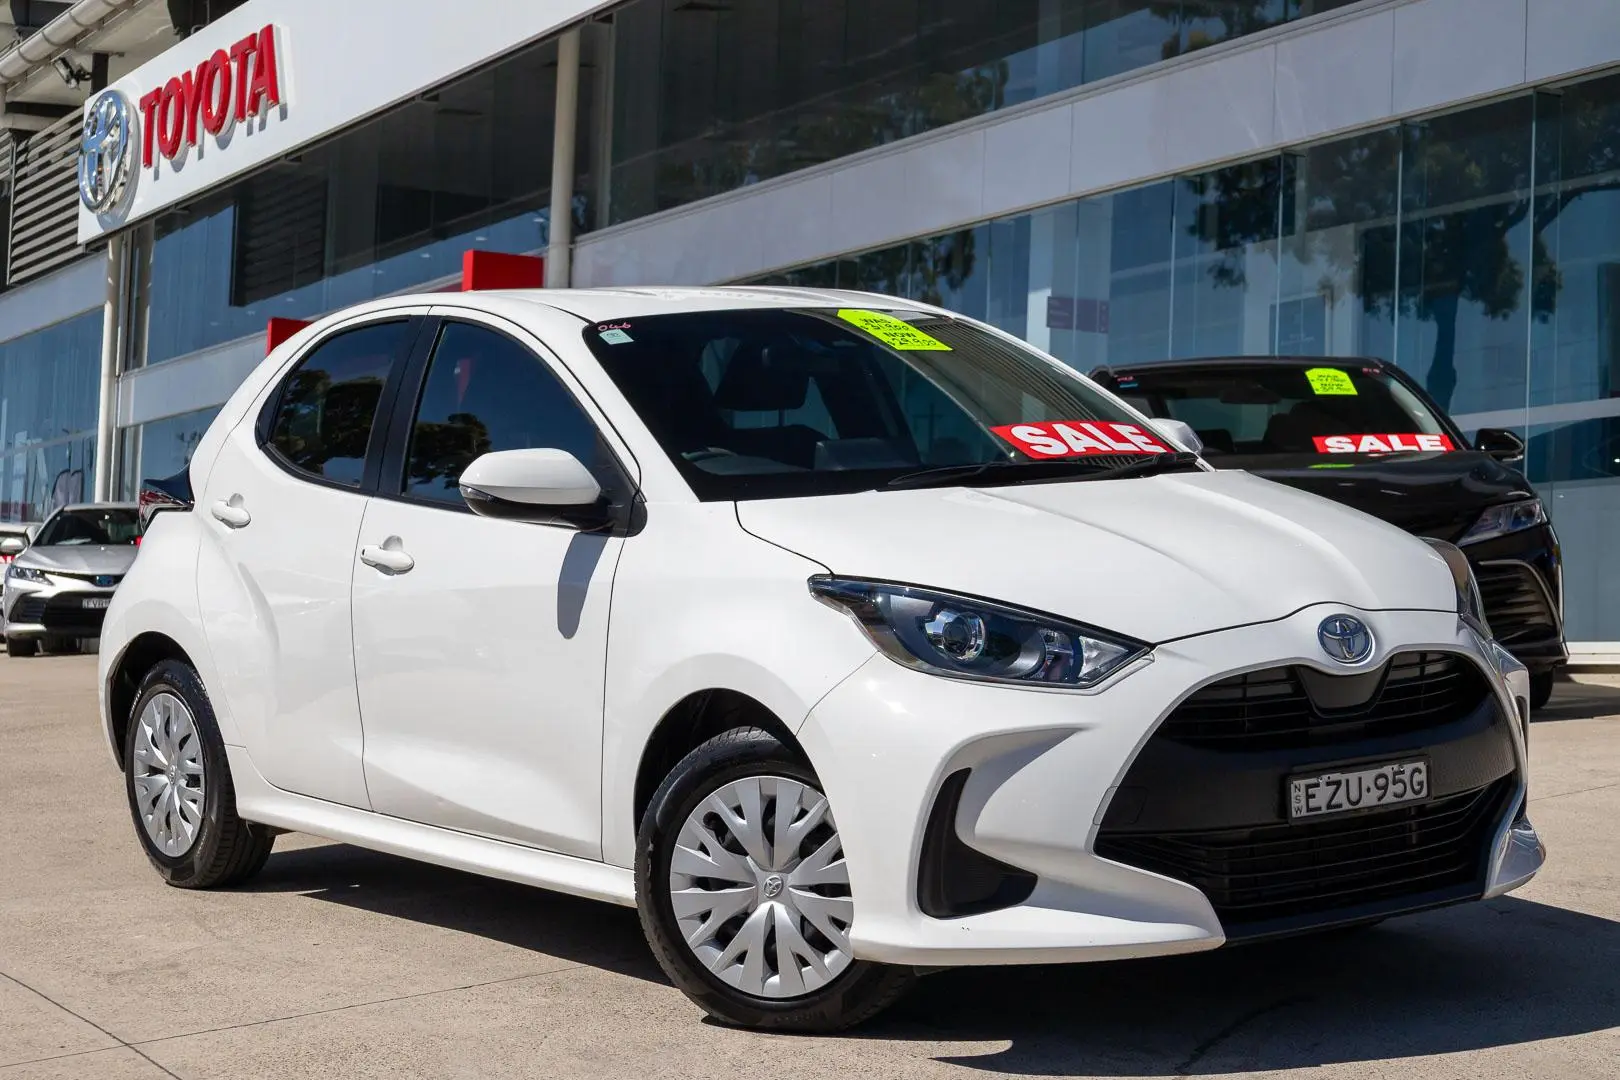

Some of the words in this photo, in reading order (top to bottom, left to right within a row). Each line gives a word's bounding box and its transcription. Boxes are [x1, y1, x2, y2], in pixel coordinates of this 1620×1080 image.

[139, 23, 280, 169] TOYOTA
[1010, 423, 1167, 455] SALE
[1323, 434, 1447, 453] SALE
[1293, 783, 1303, 815] NSW
